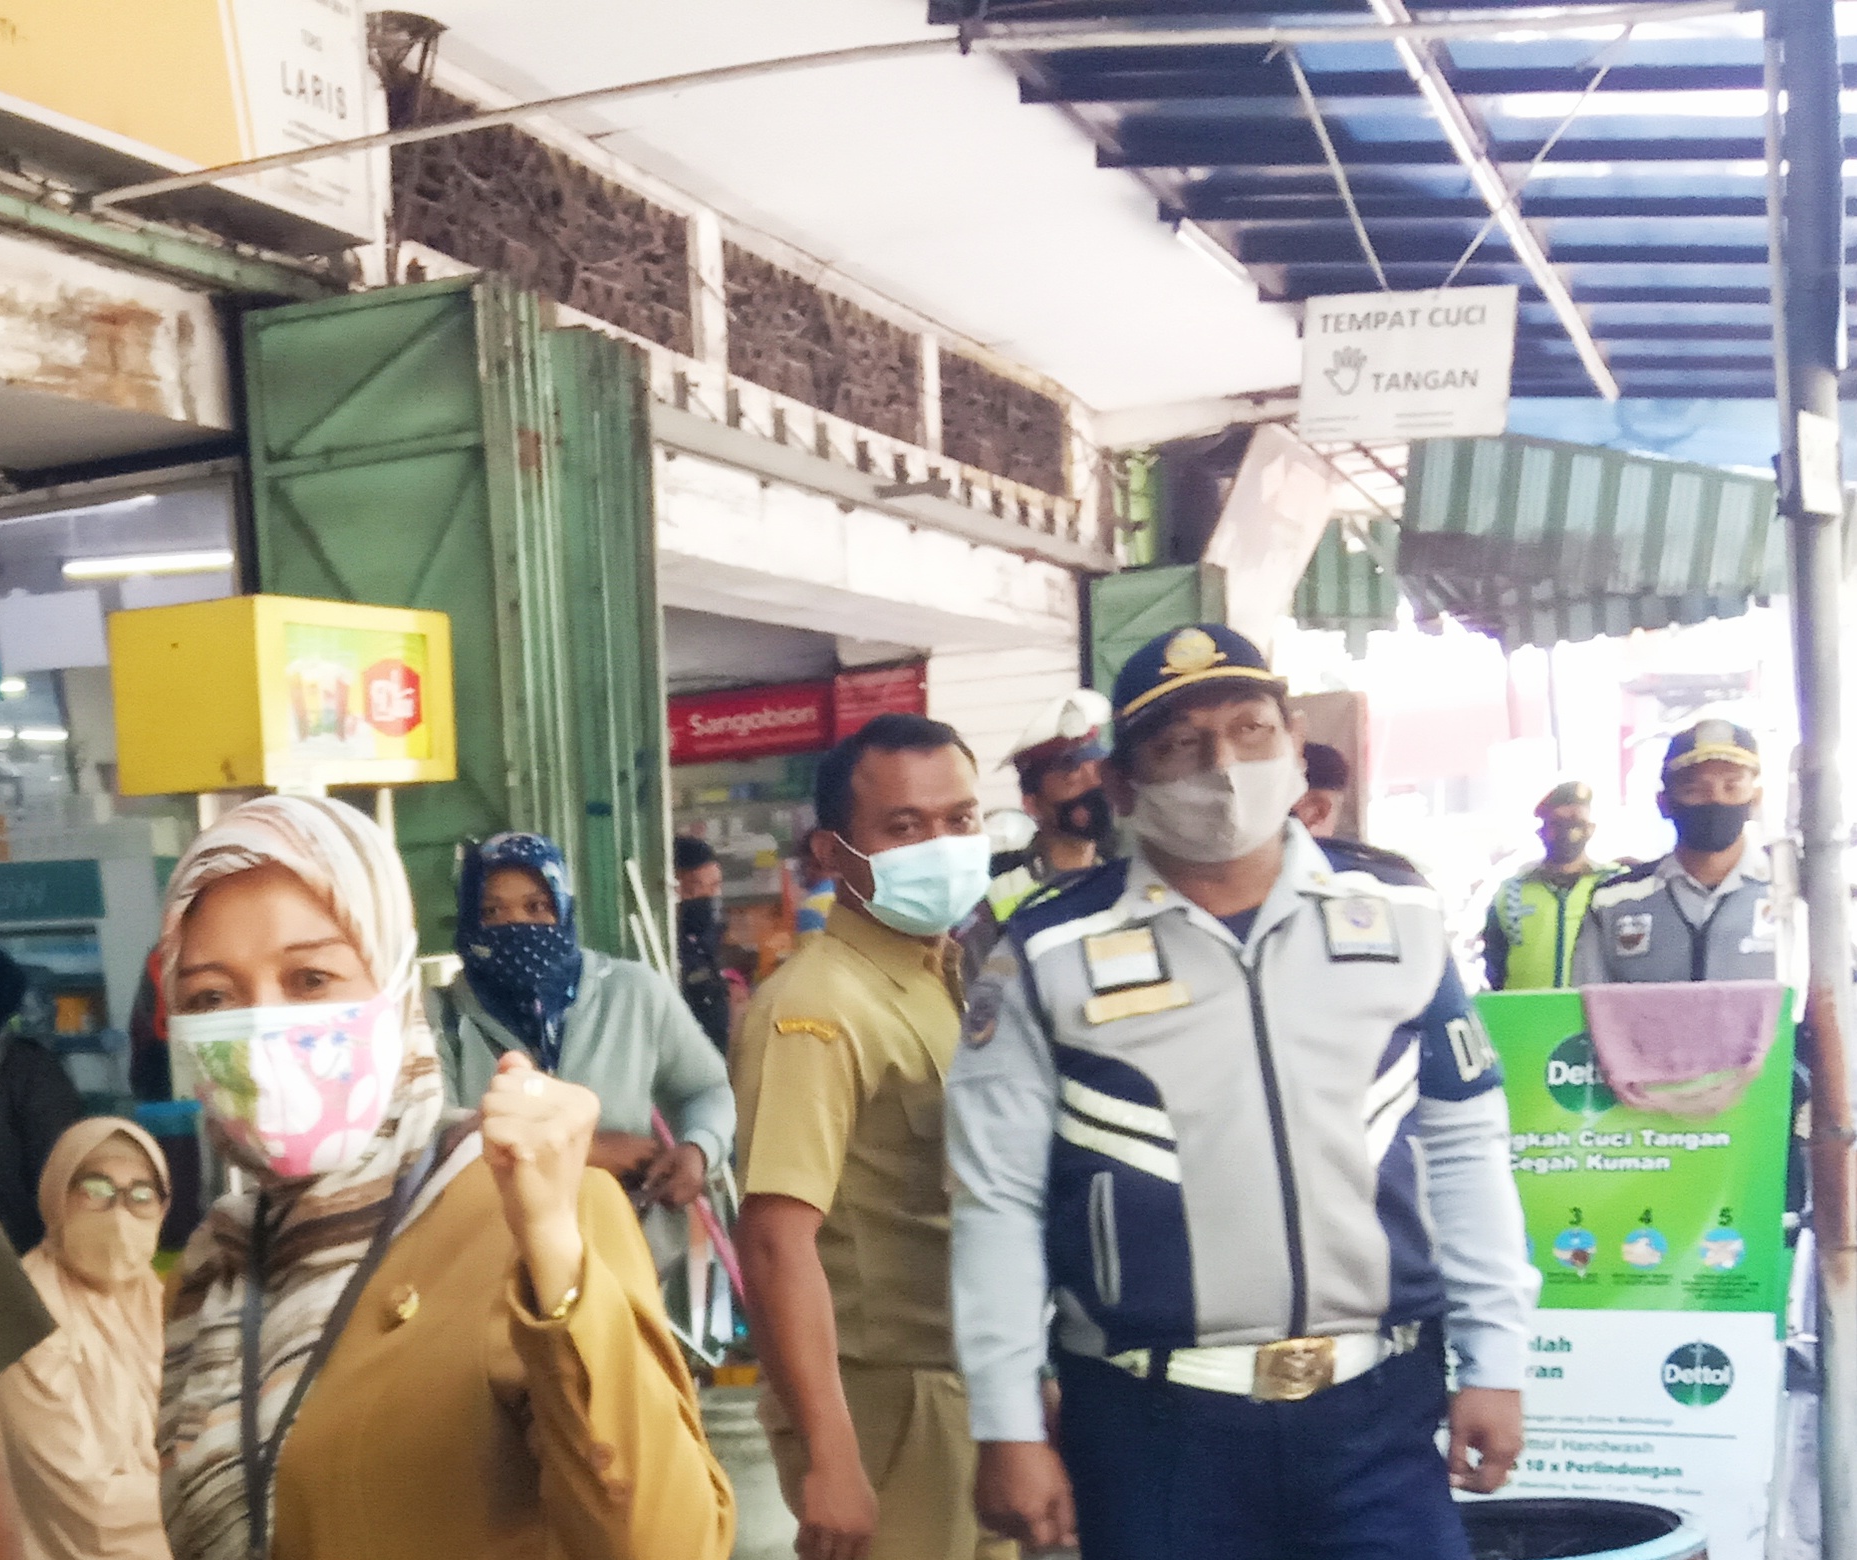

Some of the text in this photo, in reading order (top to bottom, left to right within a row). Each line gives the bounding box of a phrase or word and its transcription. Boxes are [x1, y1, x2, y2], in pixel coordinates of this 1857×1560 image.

[280, 60, 348, 121] LARIS
[1320, 304, 1487, 334] TEMPAT CUCI
[1372, 368, 1480, 393] TANGAN
[1547, 1060, 1604, 1086] Det
[1509, 1128, 1731, 1151] gkah Cuci Tangan
[1585, 1154, 1671, 1172] Kuman
[1569, 1206, 1584, 1227] 3
[1638, 1206, 1653, 1226] 4
[1718, 1206, 1734, 1227] 5
[1665, 1363, 1732, 1386] Dettol
